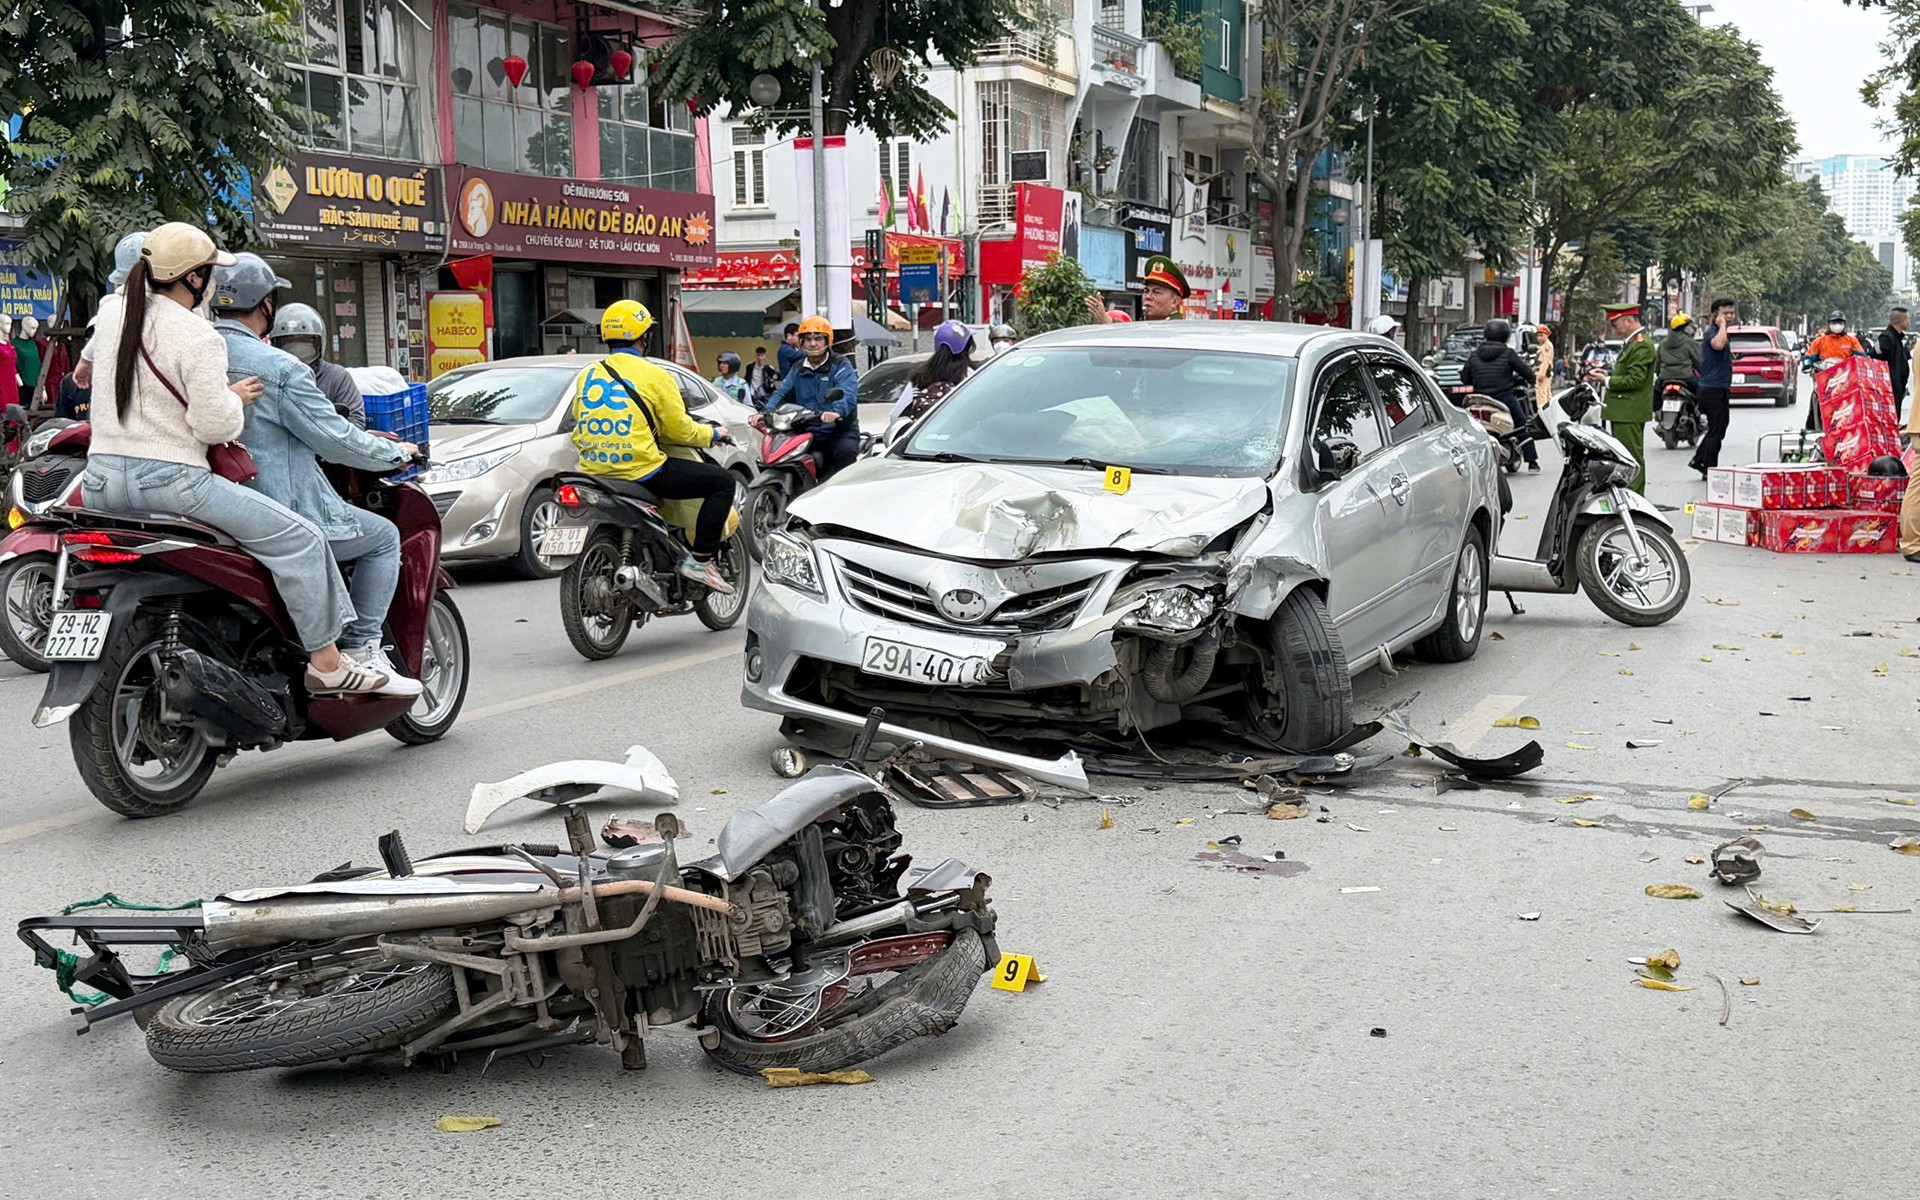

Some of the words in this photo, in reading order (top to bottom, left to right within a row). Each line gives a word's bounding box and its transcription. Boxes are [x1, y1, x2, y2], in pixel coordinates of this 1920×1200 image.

[367, 174, 383, 201] O
[386, 168, 428, 206] QUẾ
[502, 197, 542, 226] NHÀ
[546, 199, 596, 231] HÀNG
[599, 204, 621, 233] DÊ
[623, 205, 656, 236] BẢO
[659, 216, 682, 238] AN
[525, 234, 553, 247] CHUYÊN
[554, 237, 564, 247] DÊ
[565, 238, 583, 248] QUAY
[589, 237, 598, 249] DÊ
[437, 326, 477, 336] HABECO
[582, 367, 635, 410] be
[578, 411, 633, 437] Food
[1112, 470, 1121, 485] 8
[57, 614, 101, 634] 29-H2
[46, 637, 99, 656] 227.12
[1004, 959, 1019, 982] 9
